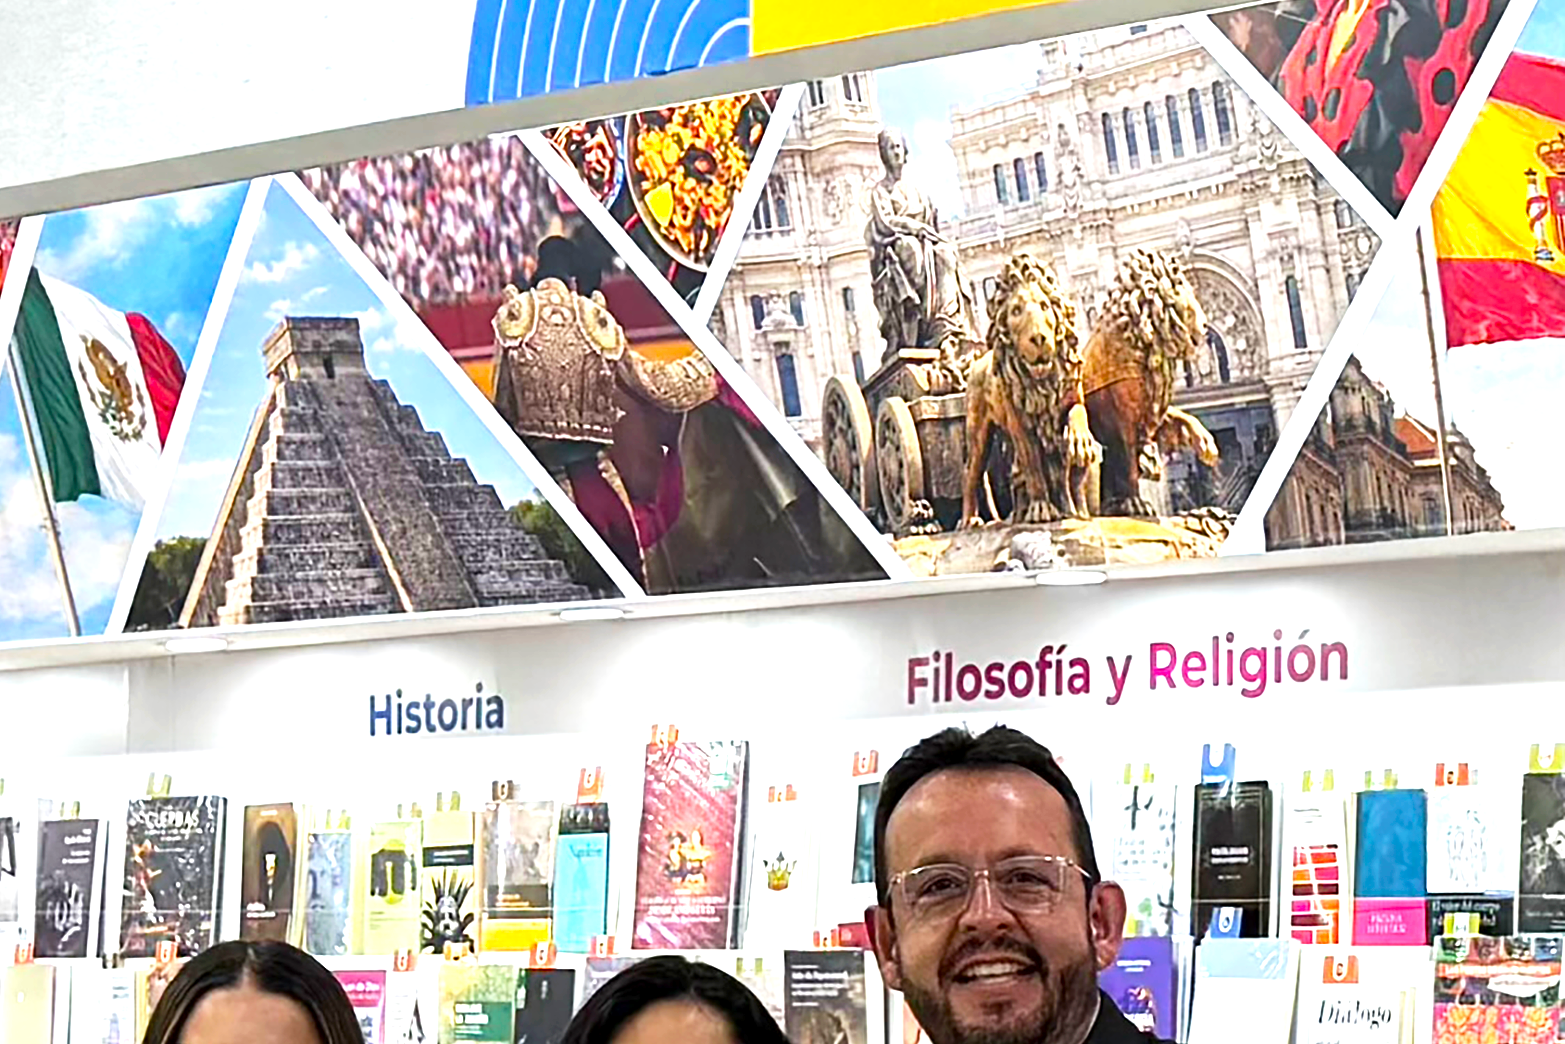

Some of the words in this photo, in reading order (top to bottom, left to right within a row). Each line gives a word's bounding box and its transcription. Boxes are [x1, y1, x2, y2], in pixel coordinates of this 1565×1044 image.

[907, 644, 1090, 704] Filosofía
[1106, 653, 1132, 705] y
[1149, 628, 1349, 699] Religión
[369, 682, 504, 736] Historia
